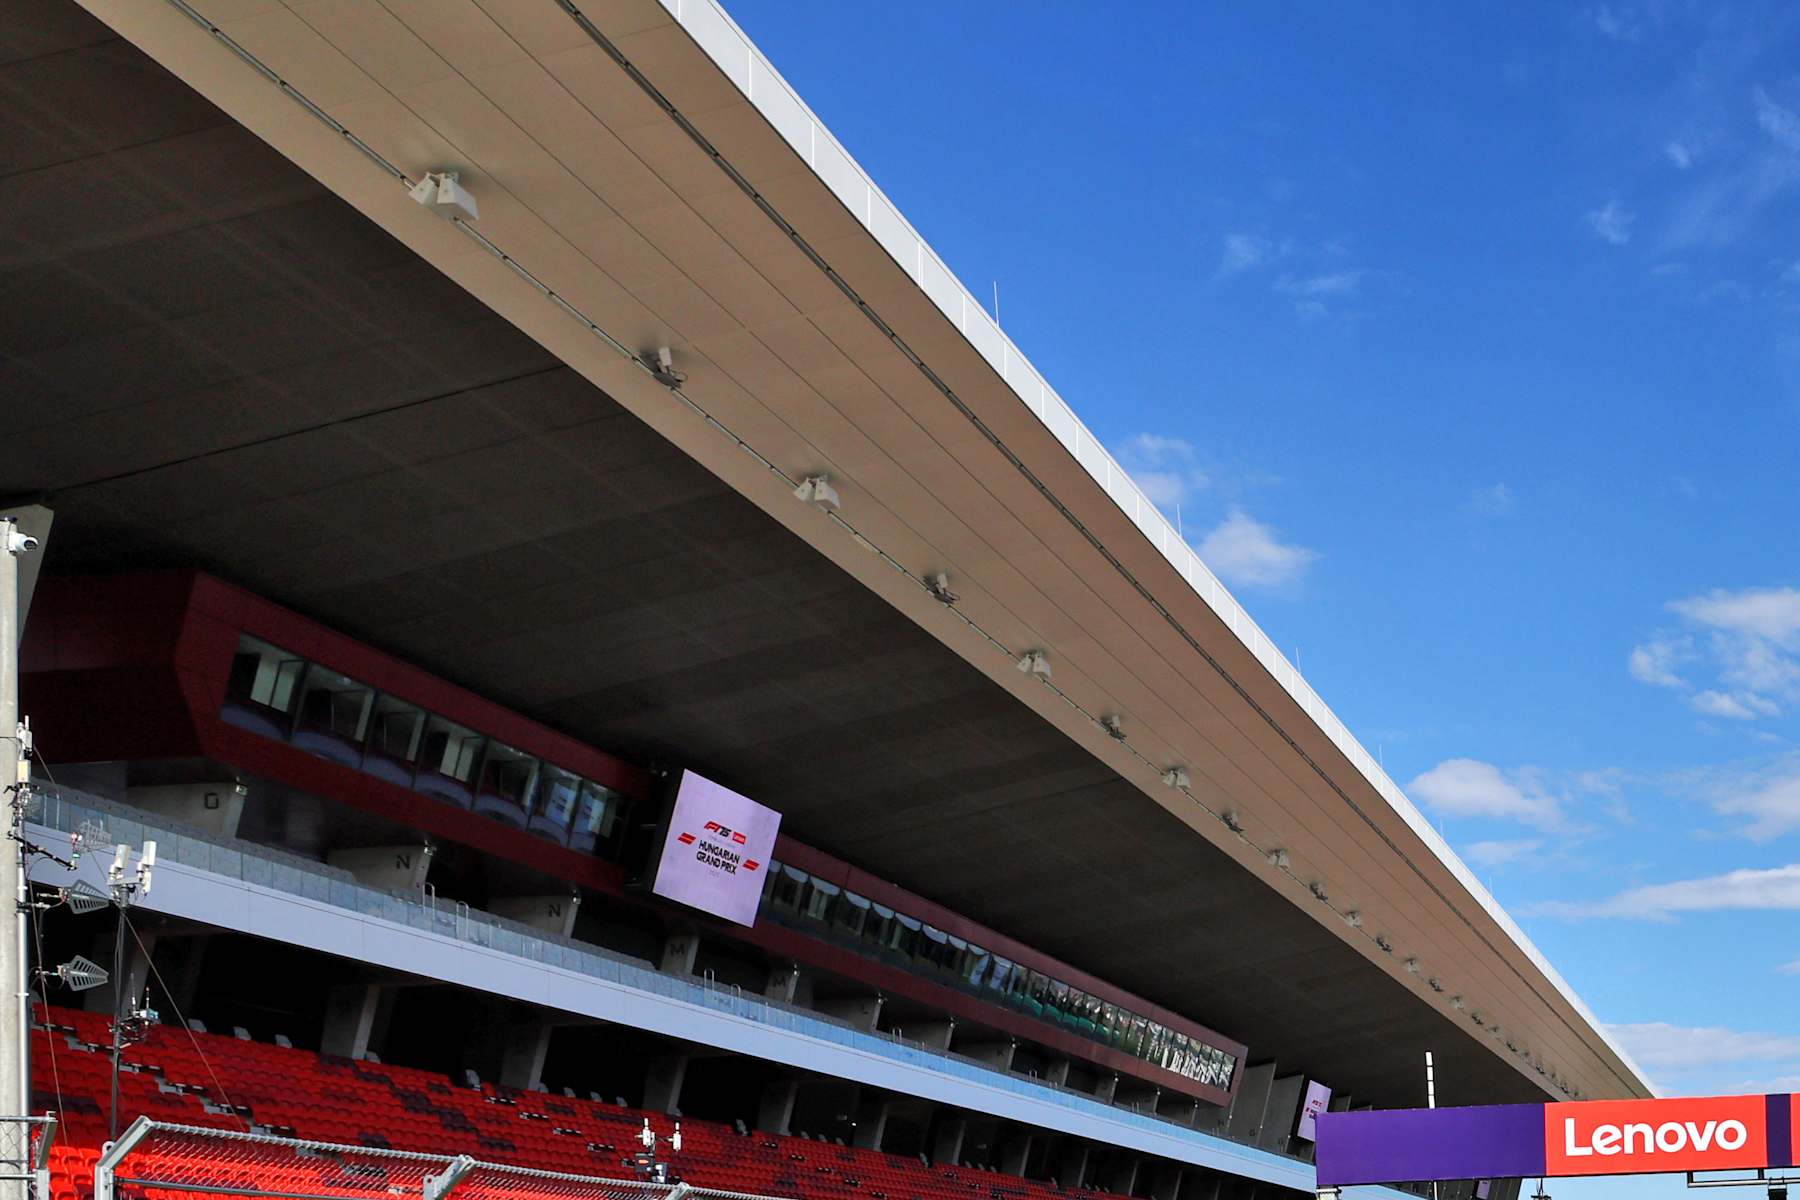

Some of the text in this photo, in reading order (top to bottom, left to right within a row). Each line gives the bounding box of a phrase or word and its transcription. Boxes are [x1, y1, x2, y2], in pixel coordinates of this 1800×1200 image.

[696, 851, 721, 869] GRAND
[721, 861, 738, 875] PRIX
[698, 839, 741, 865] HUNGARIAN
[1564, 1117, 1748, 1157] Lenovo
